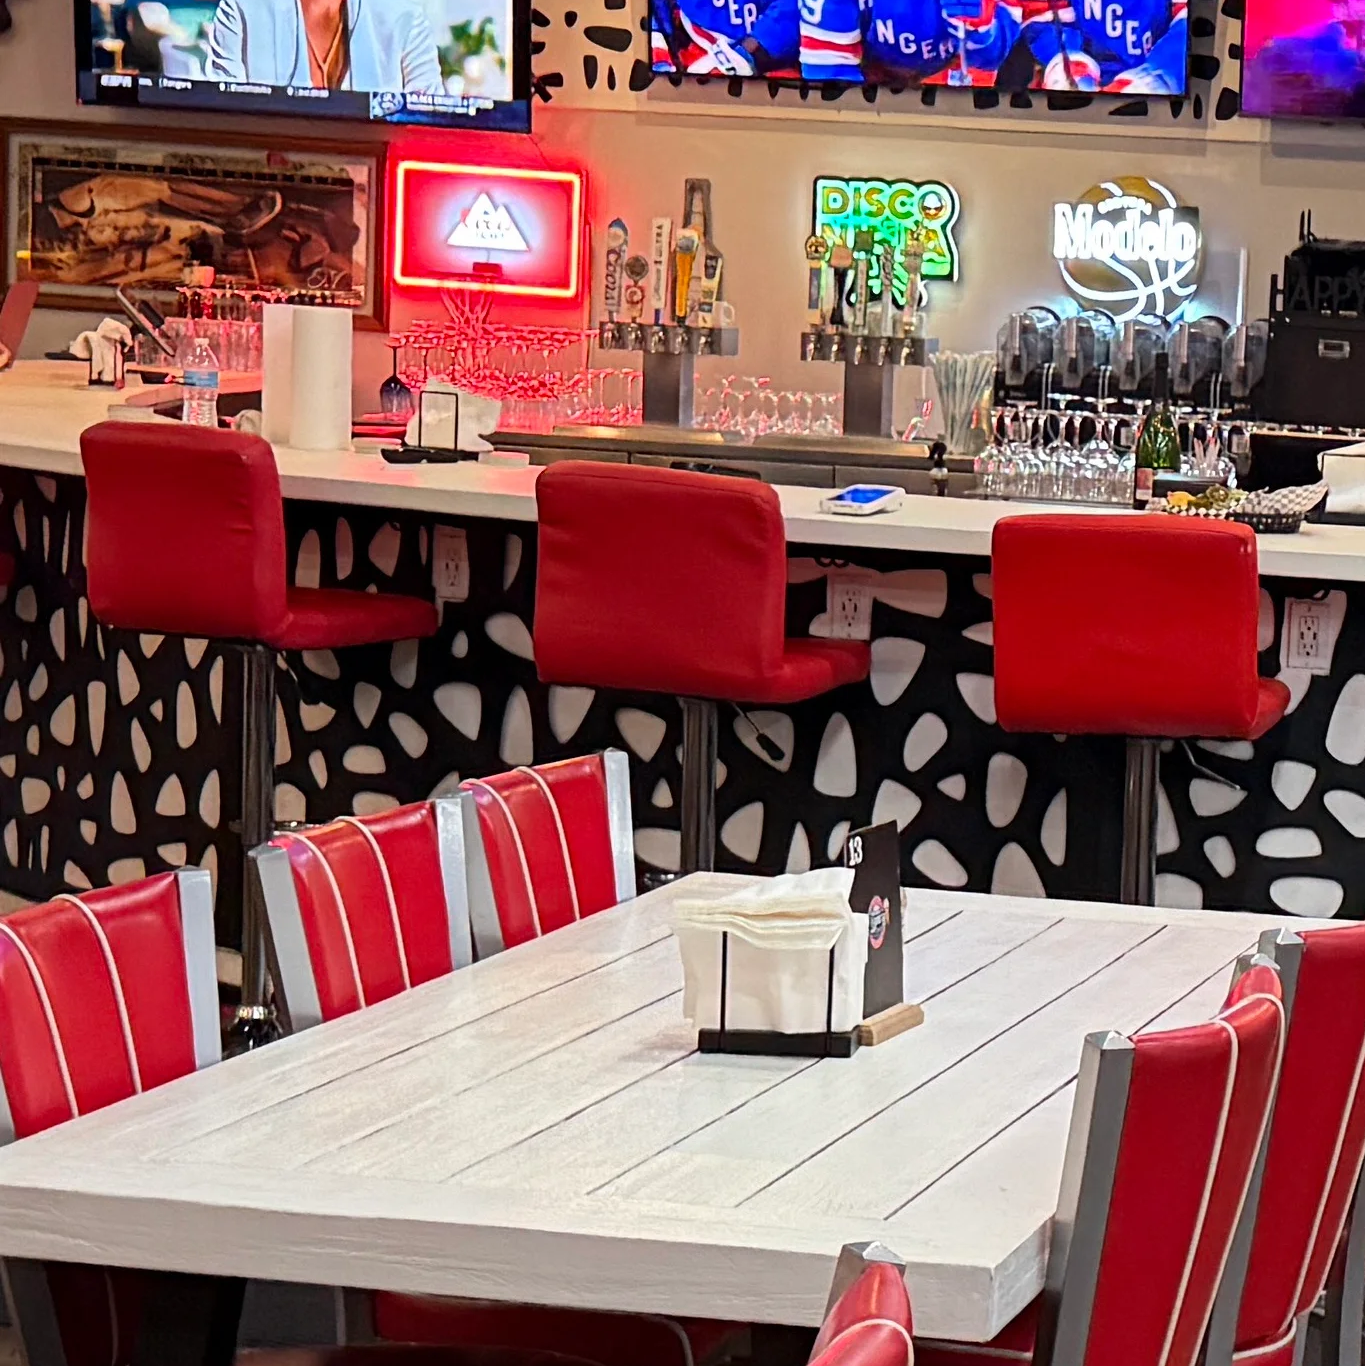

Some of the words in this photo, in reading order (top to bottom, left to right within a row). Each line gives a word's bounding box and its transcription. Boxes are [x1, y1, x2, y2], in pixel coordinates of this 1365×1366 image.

[822, 185, 947, 220] DISCO
[1053, 202, 1197, 263] Modelo
[849, 836, 862, 865] 13
